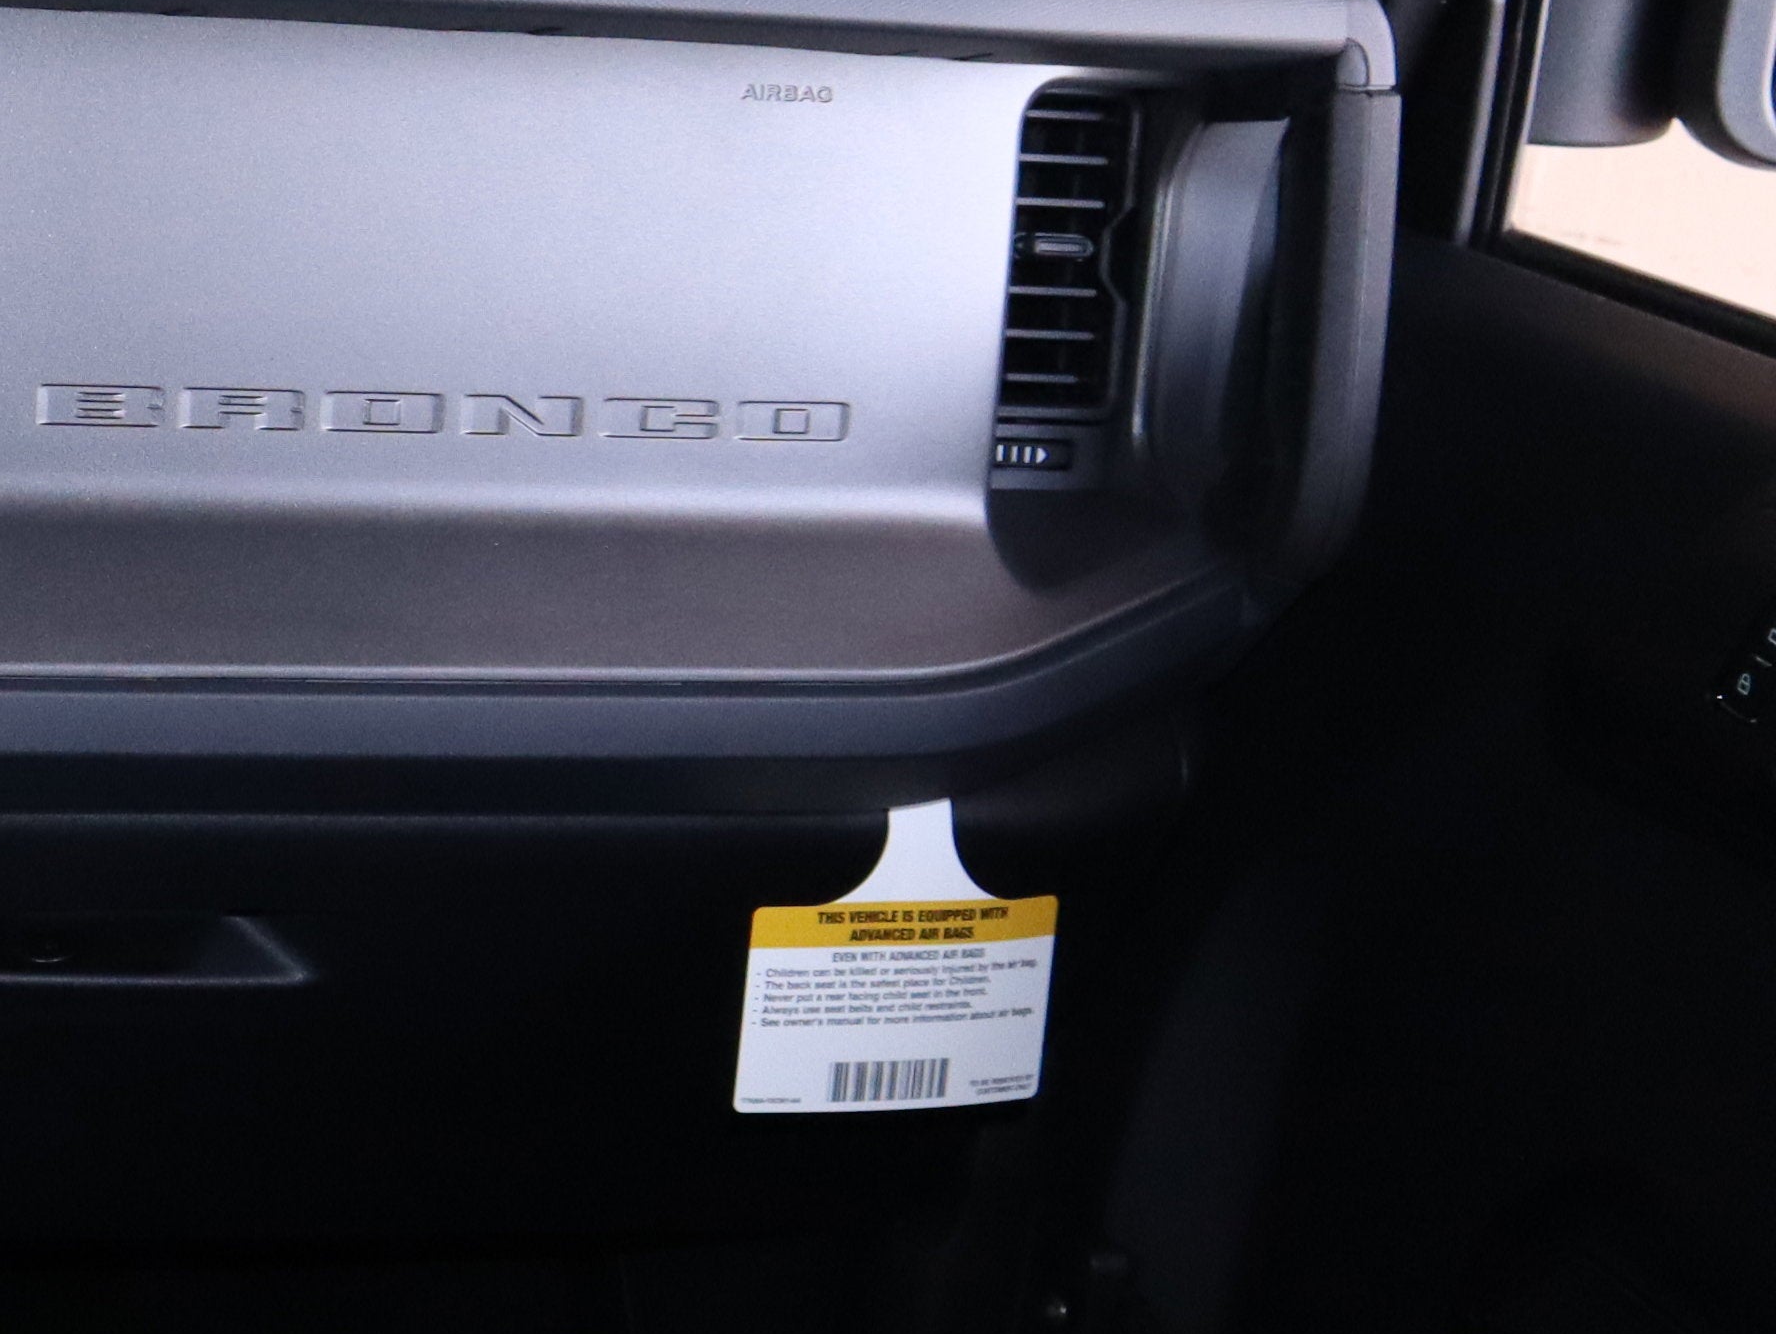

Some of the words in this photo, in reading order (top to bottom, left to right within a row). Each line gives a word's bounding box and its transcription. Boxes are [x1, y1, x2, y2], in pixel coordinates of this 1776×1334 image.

[740, 83, 834, 104] AIRBAG
[36, 382, 852, 443] BRONCO
[818, 912, 846, 924] THIS
[850, 910, 898, 923] VEHICLE
[902, 910, 914, 922] IS
[918, 908, 976, 922] EQUIPPED
[980, 907, 1009, 920] WITH
[850, 928, 915, 941] ADVANCED
[919, 927, 940, 940] AIR
[944, 926, 975, 939] BAGS
[832, 952, 857, 963] EVEN
[861, 951, 886, 962] WITH
[889, 950, 939, 961] ADVANCED
[961, 948, 985, 958] BAGS
[765, 968, 809, 978] Children
[813, 969, 831, 978] can
[834, 968, 846, 977] be
[849, 967, 876, 977] killed
[765, 981, 784, 990] The
[764, 994, 793, 1002] Never
[796, 994, 813, 1004] put
[762, 1005, 799, 1016] Always
[761, 1018, 780, 1028] See
